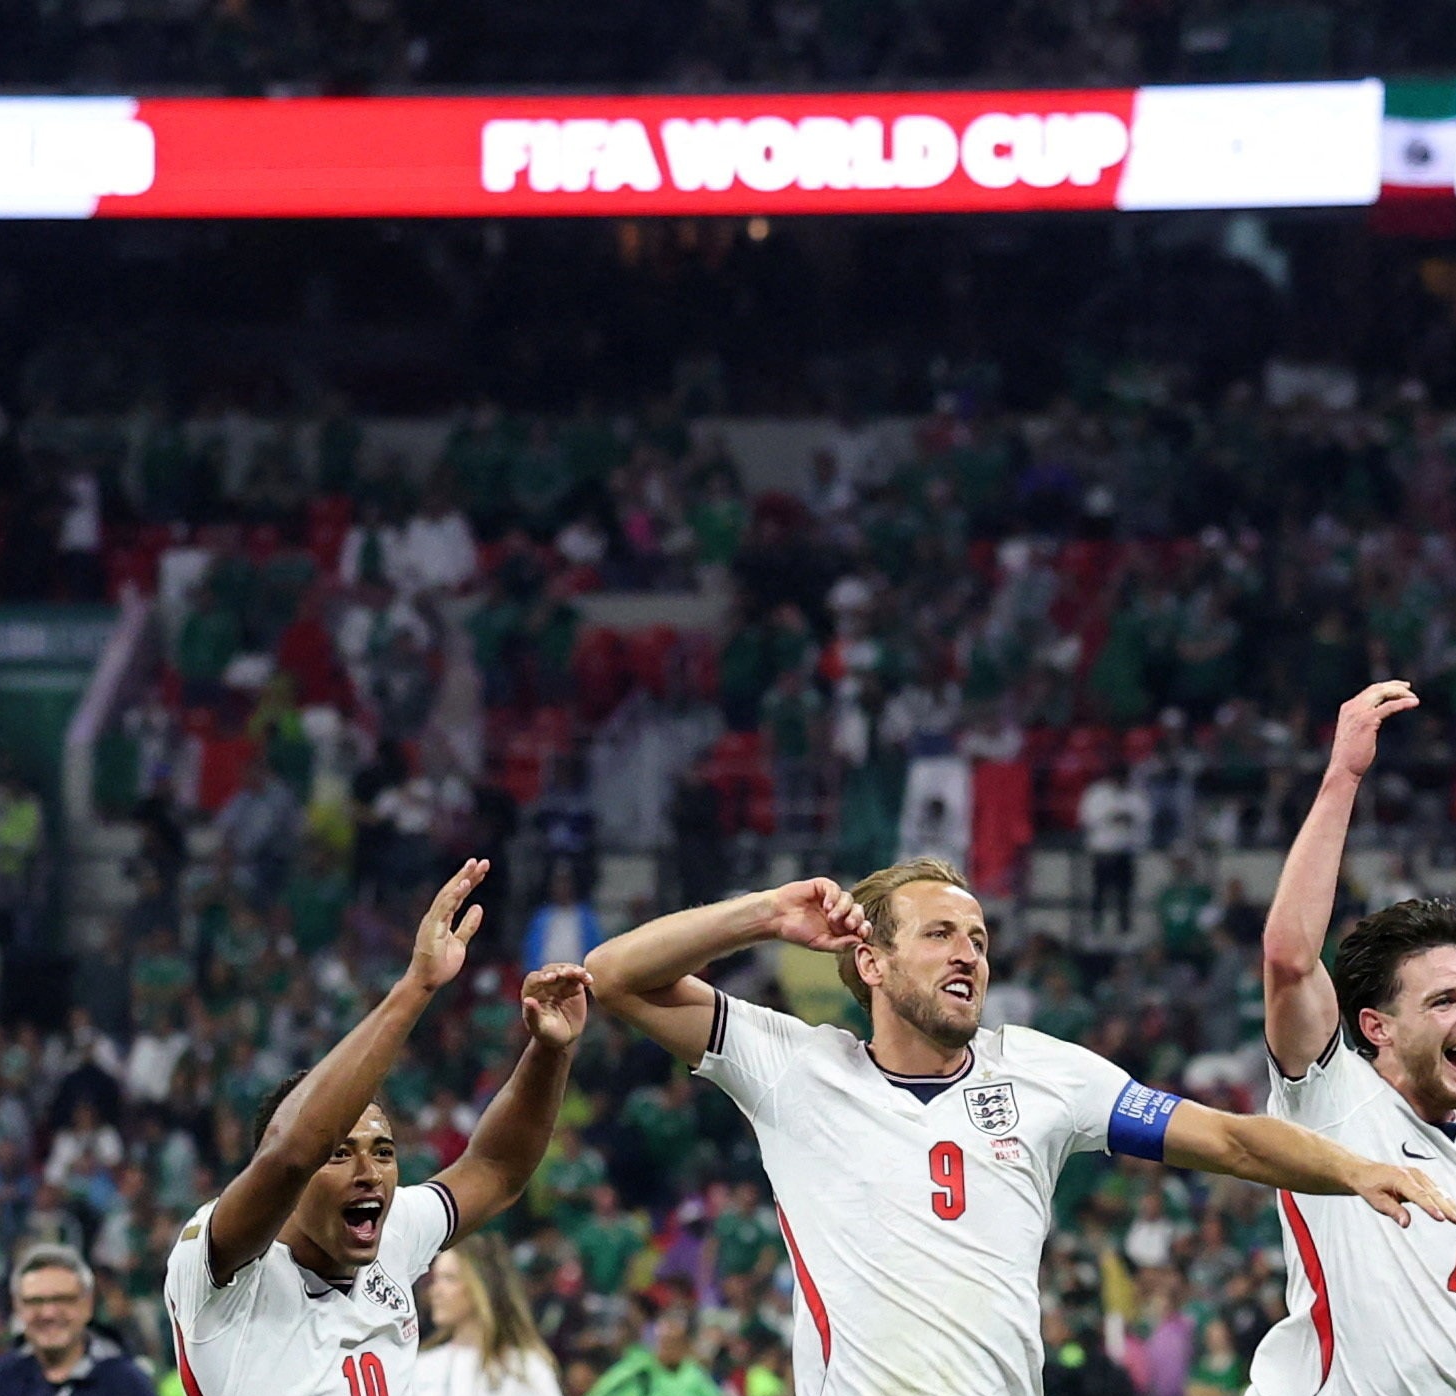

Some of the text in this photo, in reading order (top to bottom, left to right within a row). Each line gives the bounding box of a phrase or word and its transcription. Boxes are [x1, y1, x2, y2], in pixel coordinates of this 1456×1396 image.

[481, 112, 1130, 192] FIFA WORLD CUP
[1127, 1087, 1156, 1119] UNITE
[929, 1141, 966, 1220] 9
